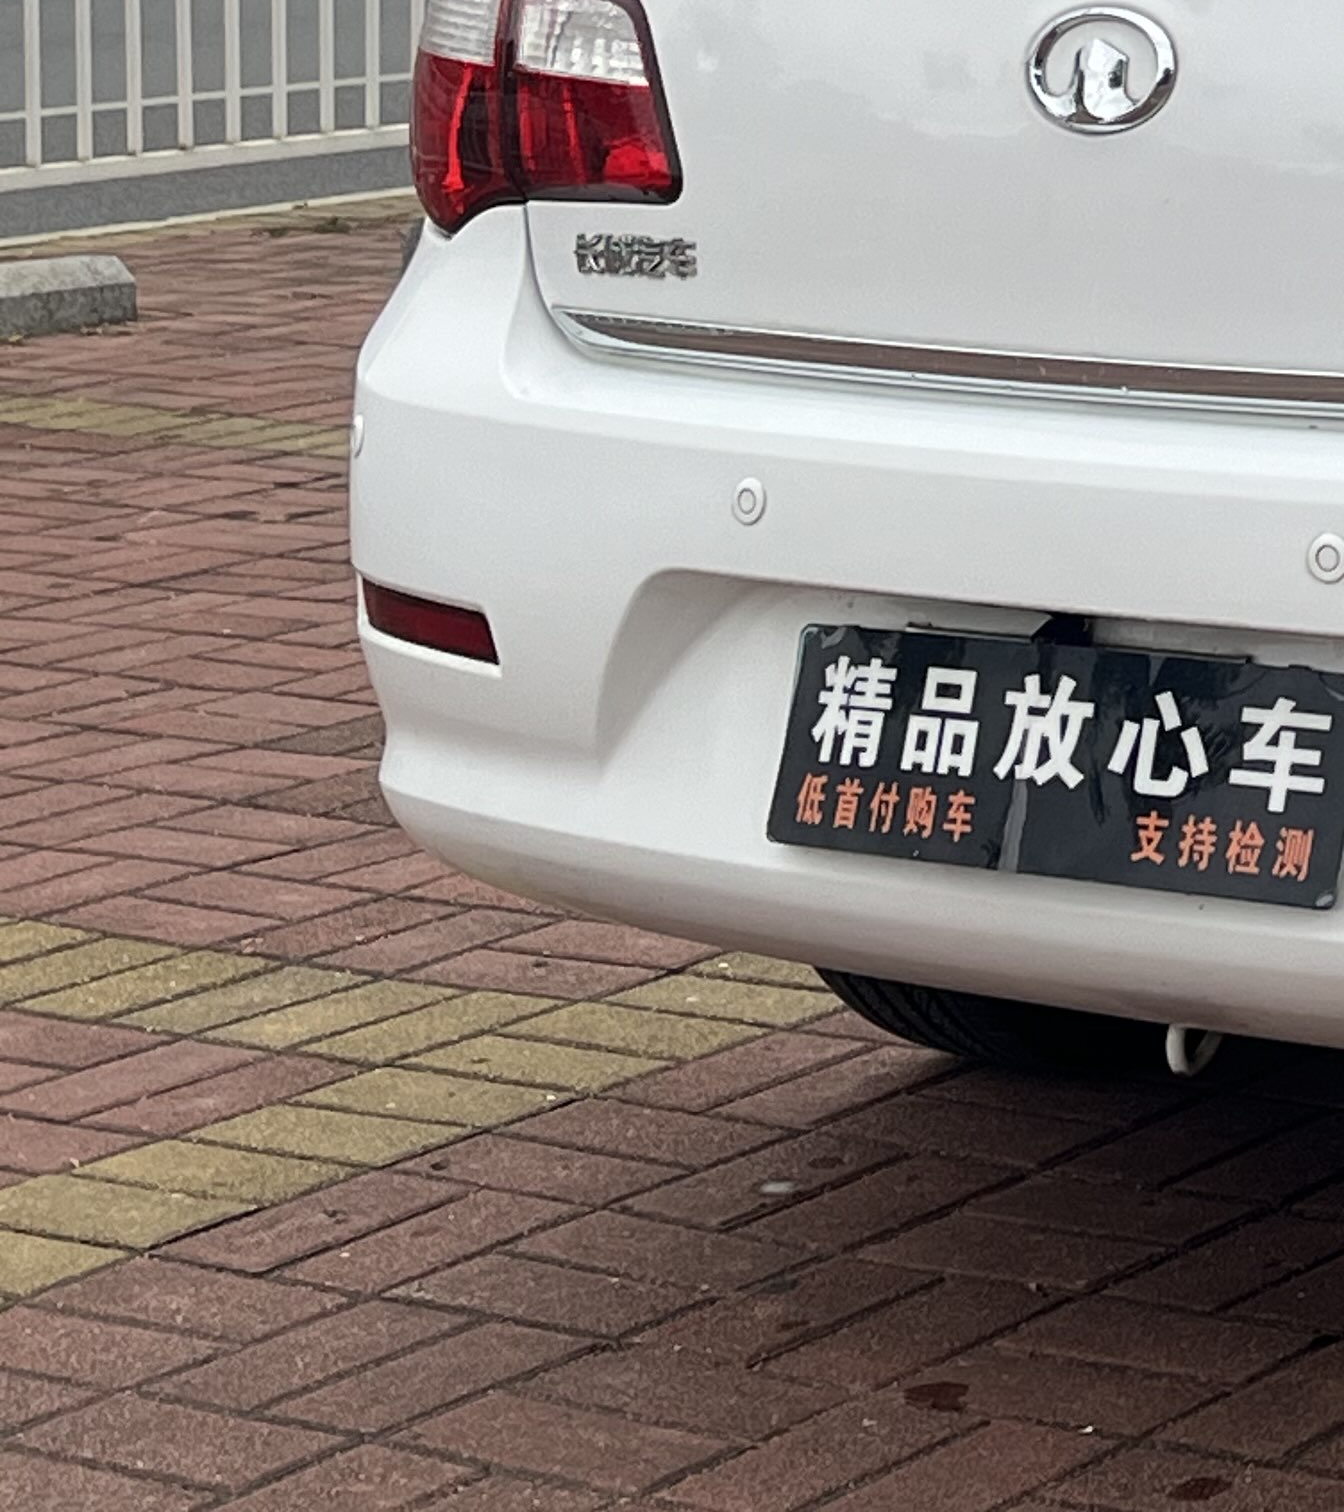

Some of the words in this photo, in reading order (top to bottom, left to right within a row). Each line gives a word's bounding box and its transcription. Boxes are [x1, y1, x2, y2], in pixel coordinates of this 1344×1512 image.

[574, 233, 698, 280] 长城汽车
[811, 654, 1333, 813] 精品放心车
[795, 772, 976, 843] 低首付购车
[1130, 810, 1314, 883] 支持检测
